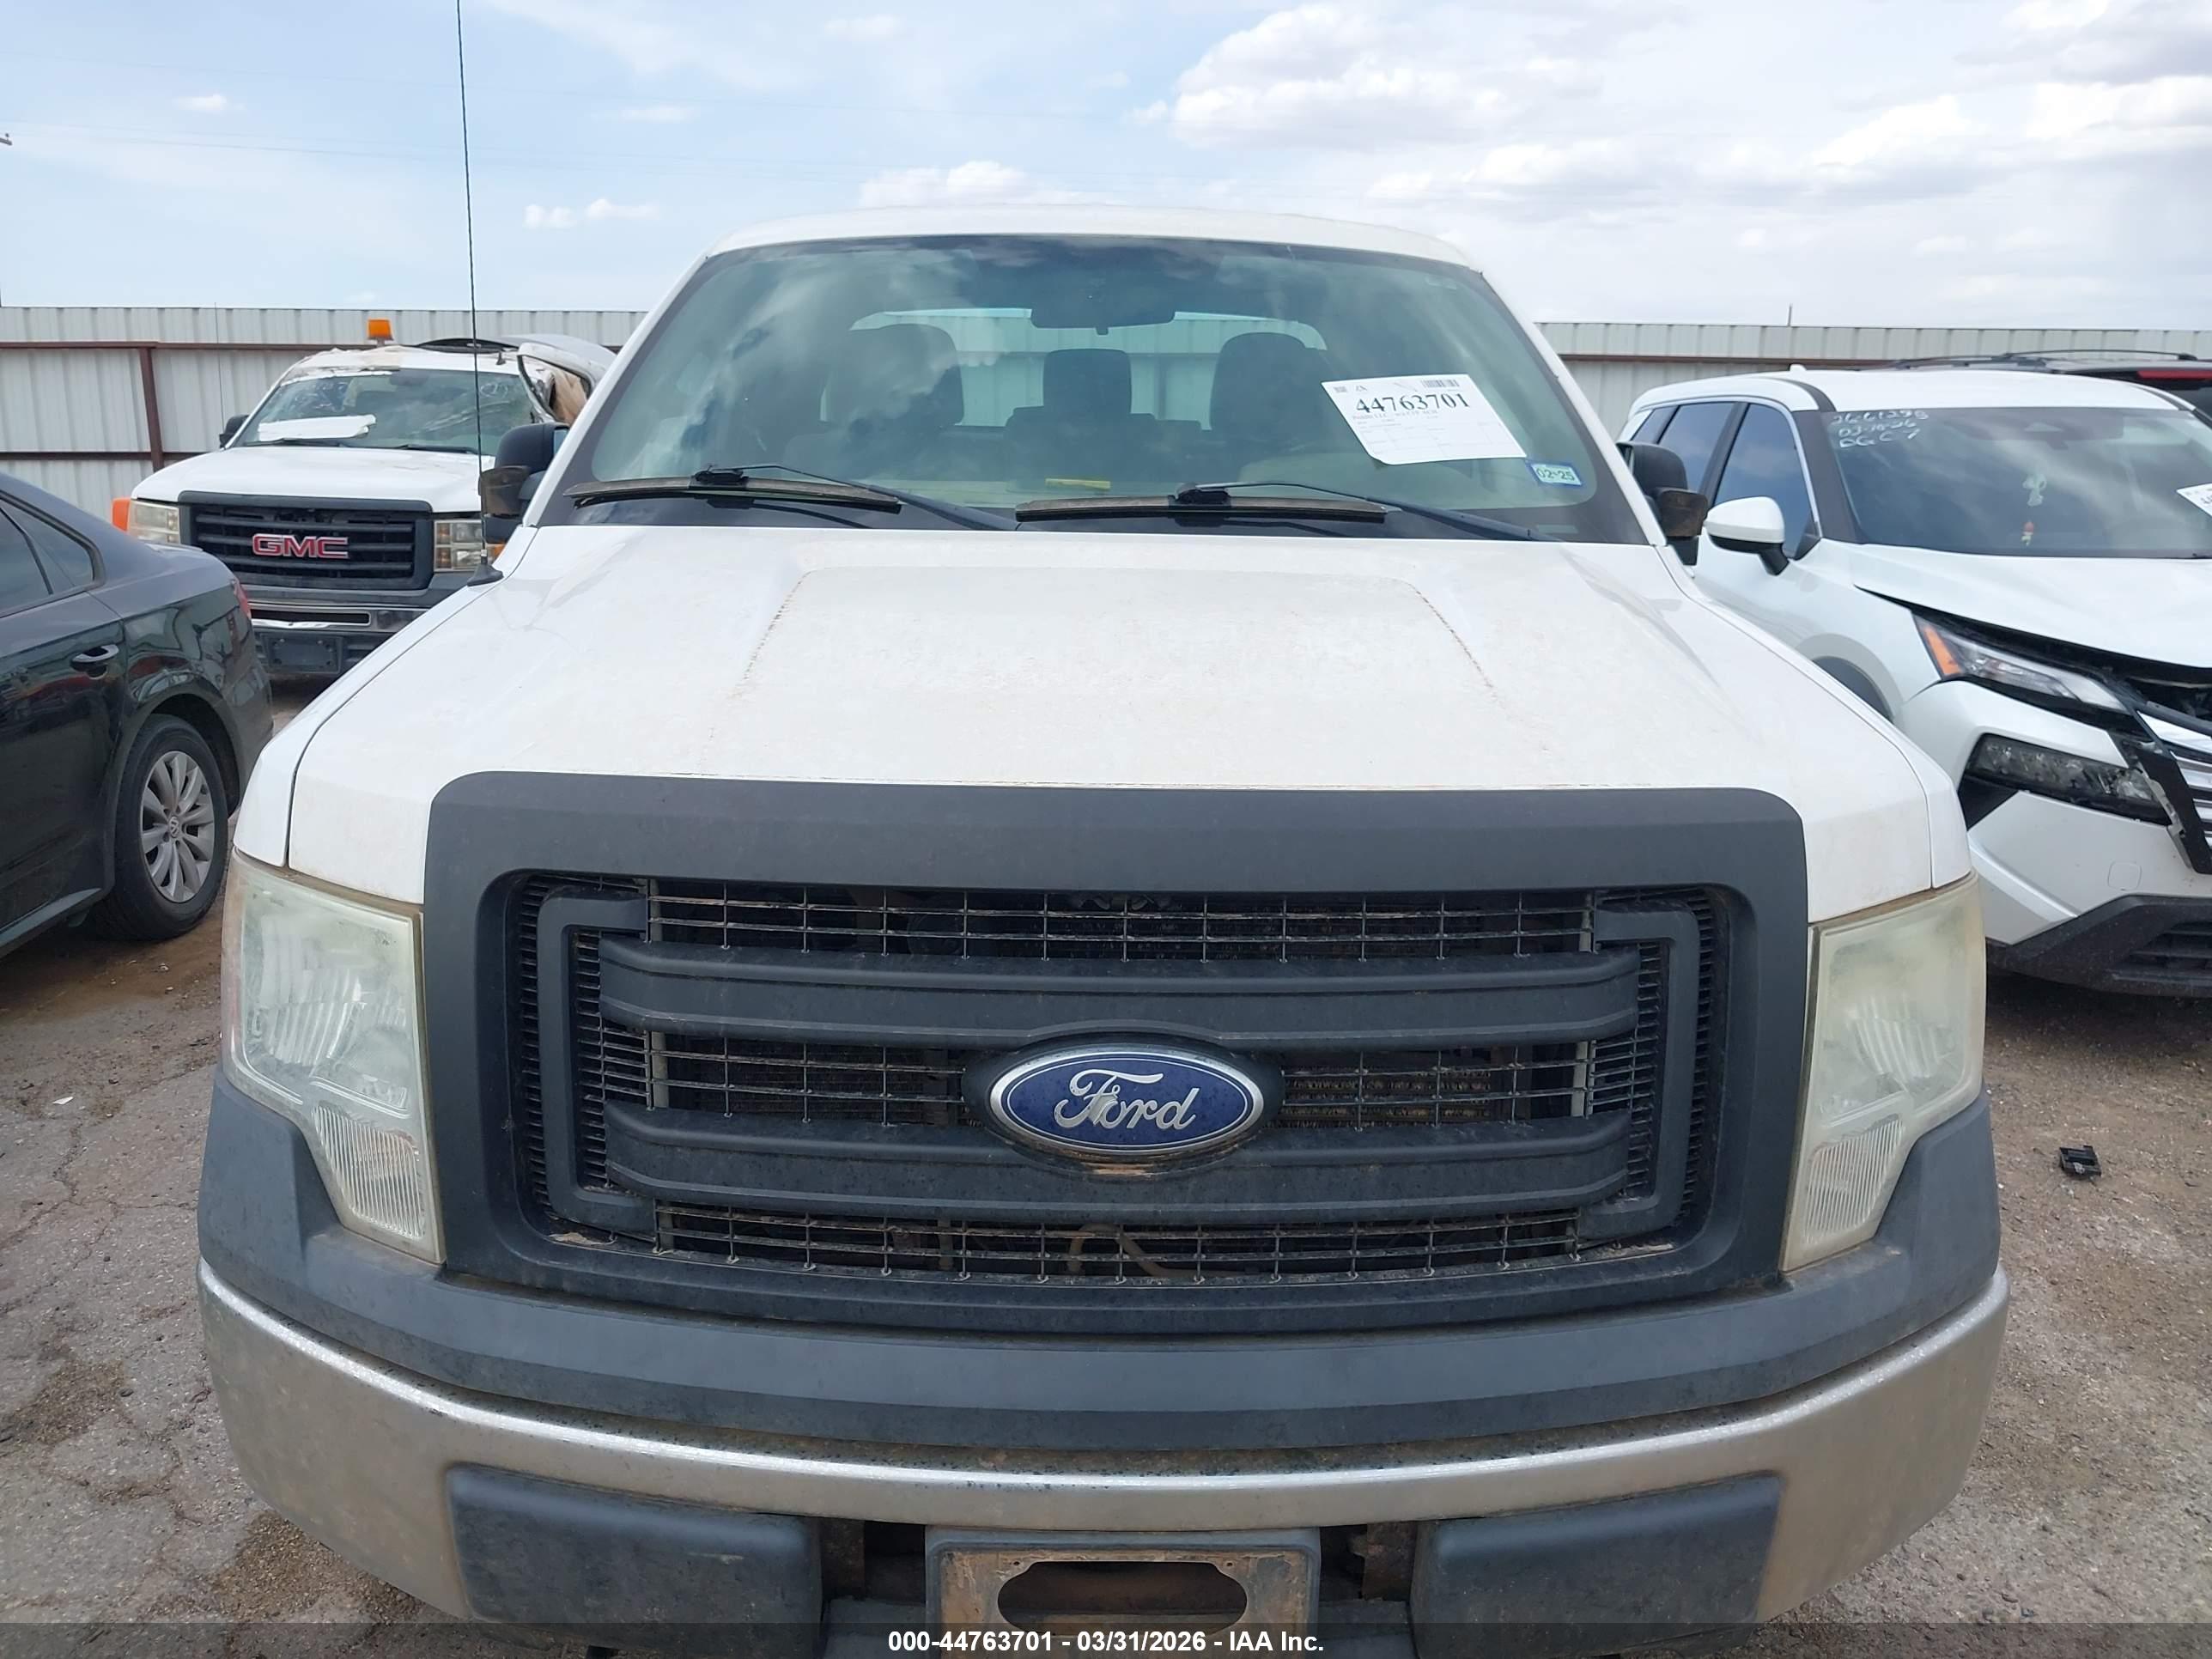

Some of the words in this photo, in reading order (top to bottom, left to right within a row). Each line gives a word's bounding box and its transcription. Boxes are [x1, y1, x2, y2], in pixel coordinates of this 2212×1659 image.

[1356, 392, 1470, 413] 44763701
[252, 532, 349, 559] GMC
[1054, 1068, 1200, 1130] Ford
